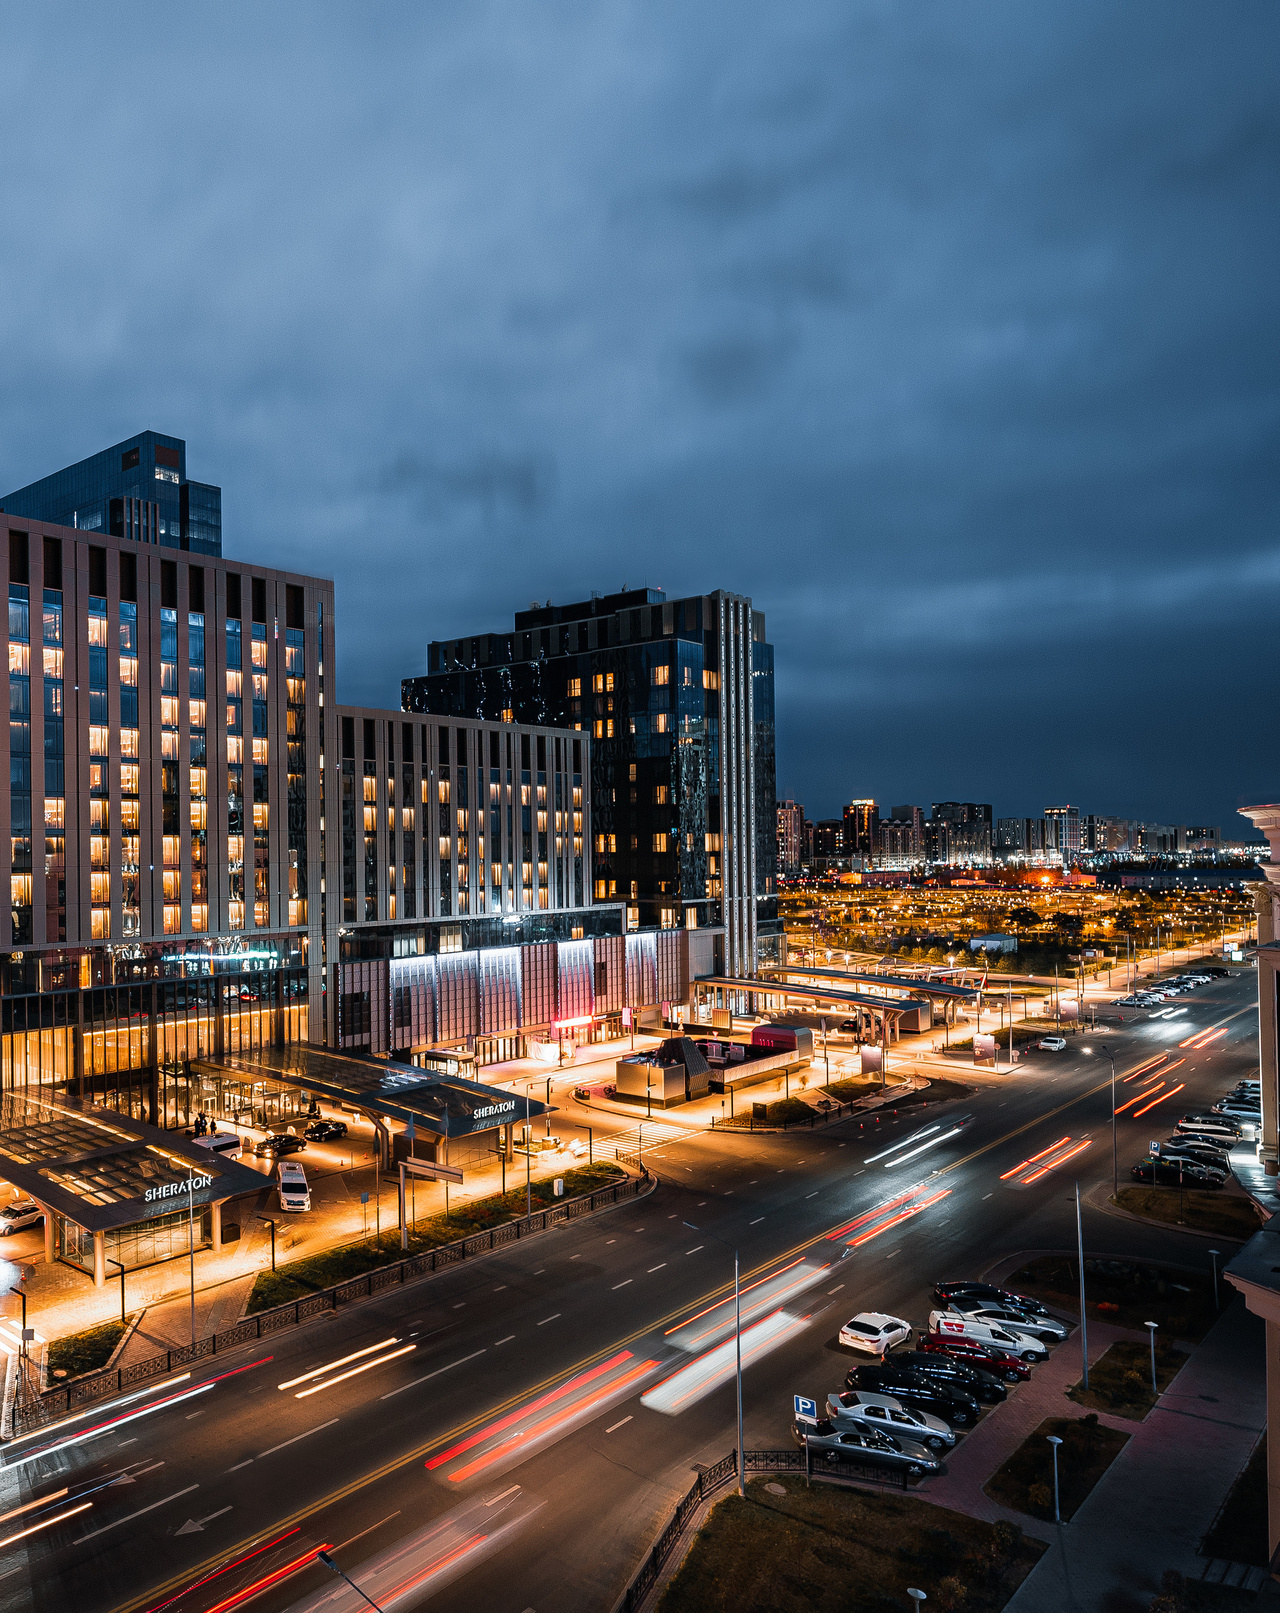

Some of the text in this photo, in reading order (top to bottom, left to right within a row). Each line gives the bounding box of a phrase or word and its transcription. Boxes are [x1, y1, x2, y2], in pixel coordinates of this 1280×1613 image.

[473, 1100, 515, 1120] SHERATON
[145, 1174, 213, 1202] SHERATON
[799, 1398, 812, 1412] P
